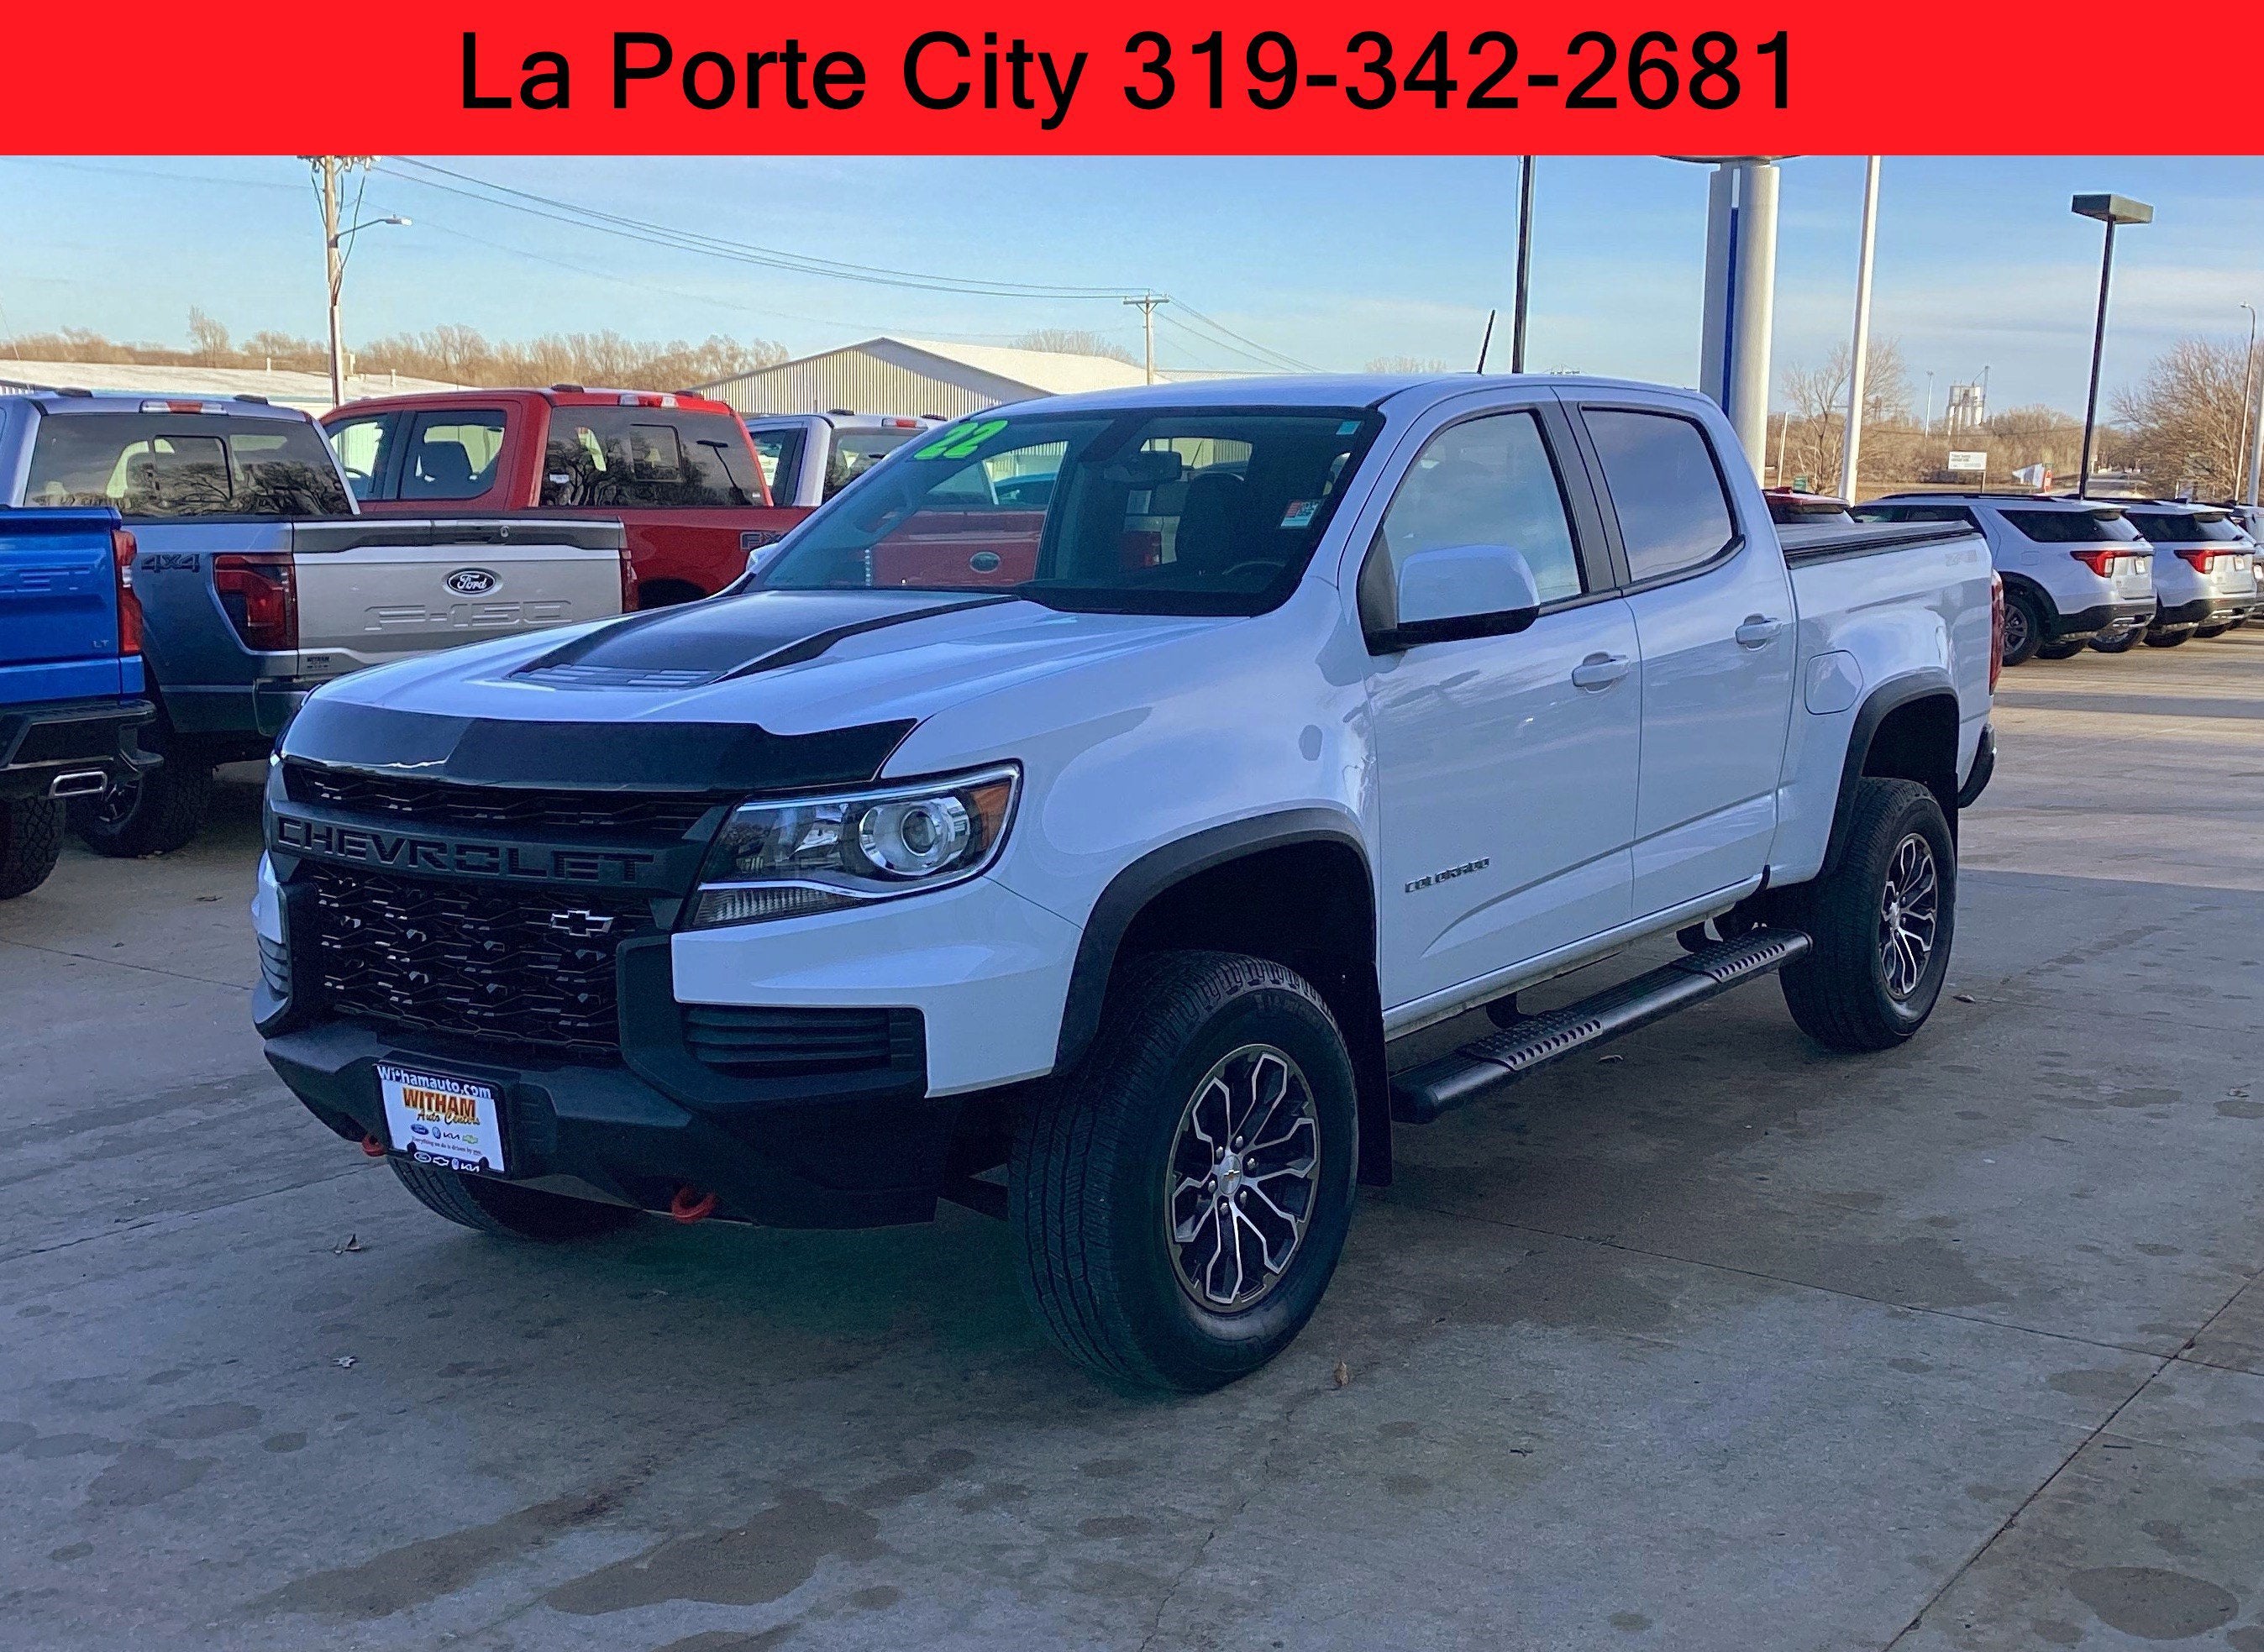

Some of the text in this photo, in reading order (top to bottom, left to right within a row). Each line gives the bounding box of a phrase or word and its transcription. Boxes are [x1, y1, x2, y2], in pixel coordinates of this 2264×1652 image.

[913, 419, 1009, 460] 22
[456, 573, 487, 590] Ford
[363, 599, 573, 631] F-150
[92, 638, 110, 648] LT
[277, 816, 657, 884] CHEVROLET
[1404, 856, 1490, 894] COLORADO
[402, 1087, 476, 1119] WITHAM
[416, 1108, 441, 1123] Auto
